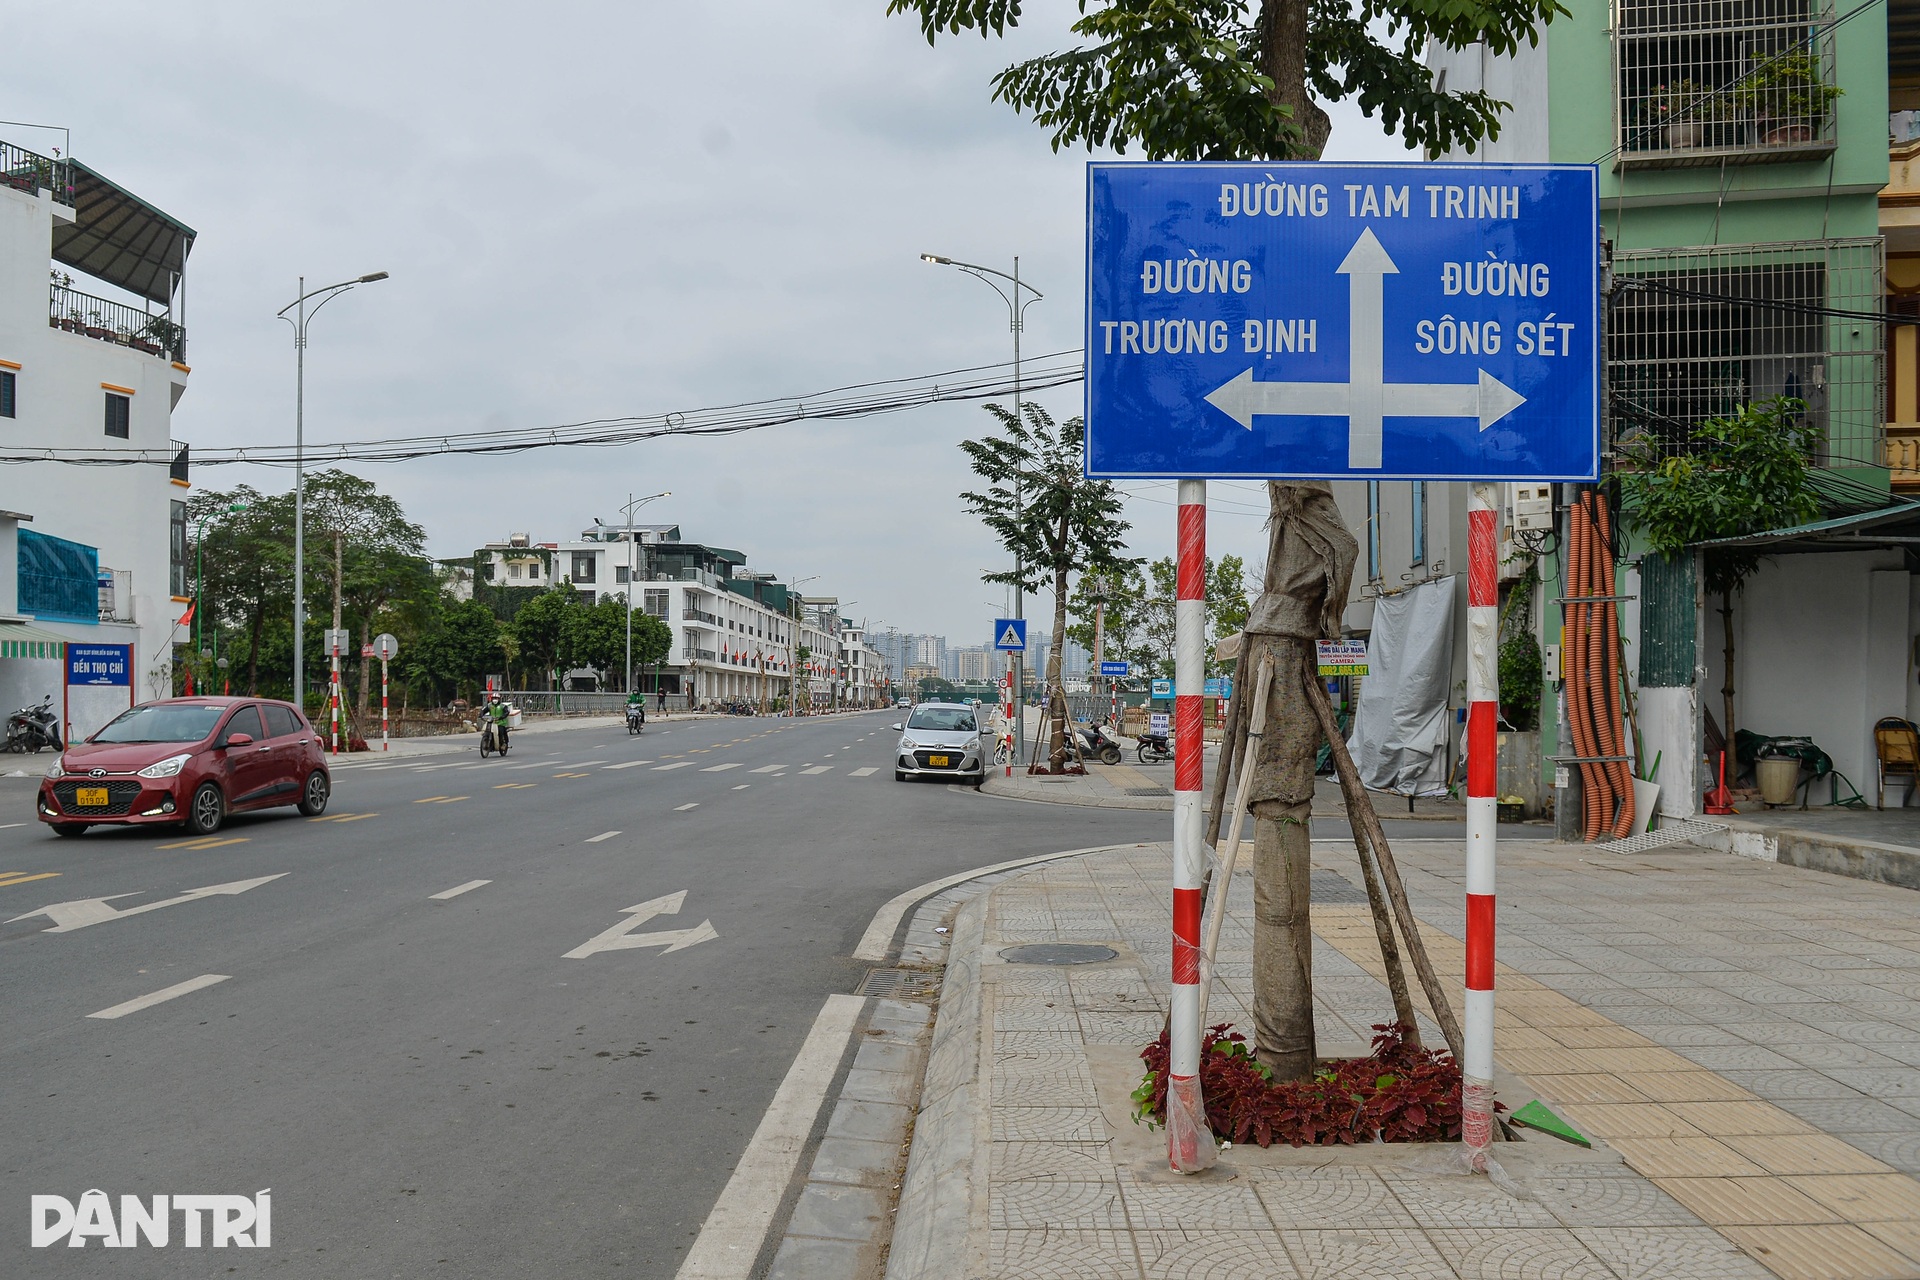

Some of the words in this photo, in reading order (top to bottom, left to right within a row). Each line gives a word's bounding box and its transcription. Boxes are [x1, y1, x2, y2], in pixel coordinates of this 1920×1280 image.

[1219, 173, 1328, 217] ĐƯỜNG
[1344, 185, 1410, 218] TAM
[1425, 185, 1520, 219] TRINH
[1141, 249, 1252, 294] ĐƯỜNG
[1440, 251, 1550, 297] ĐƯỜNG
[1100, 317, 1228, 355] TRƯƠNG
[1242, 319, 1317, 359] ĐỊNH
[1415, 314, 1501, 355] SÔNG
[1516, 312, 1575, 356] SÉT
[92, 662, 107, 676] THỌ
